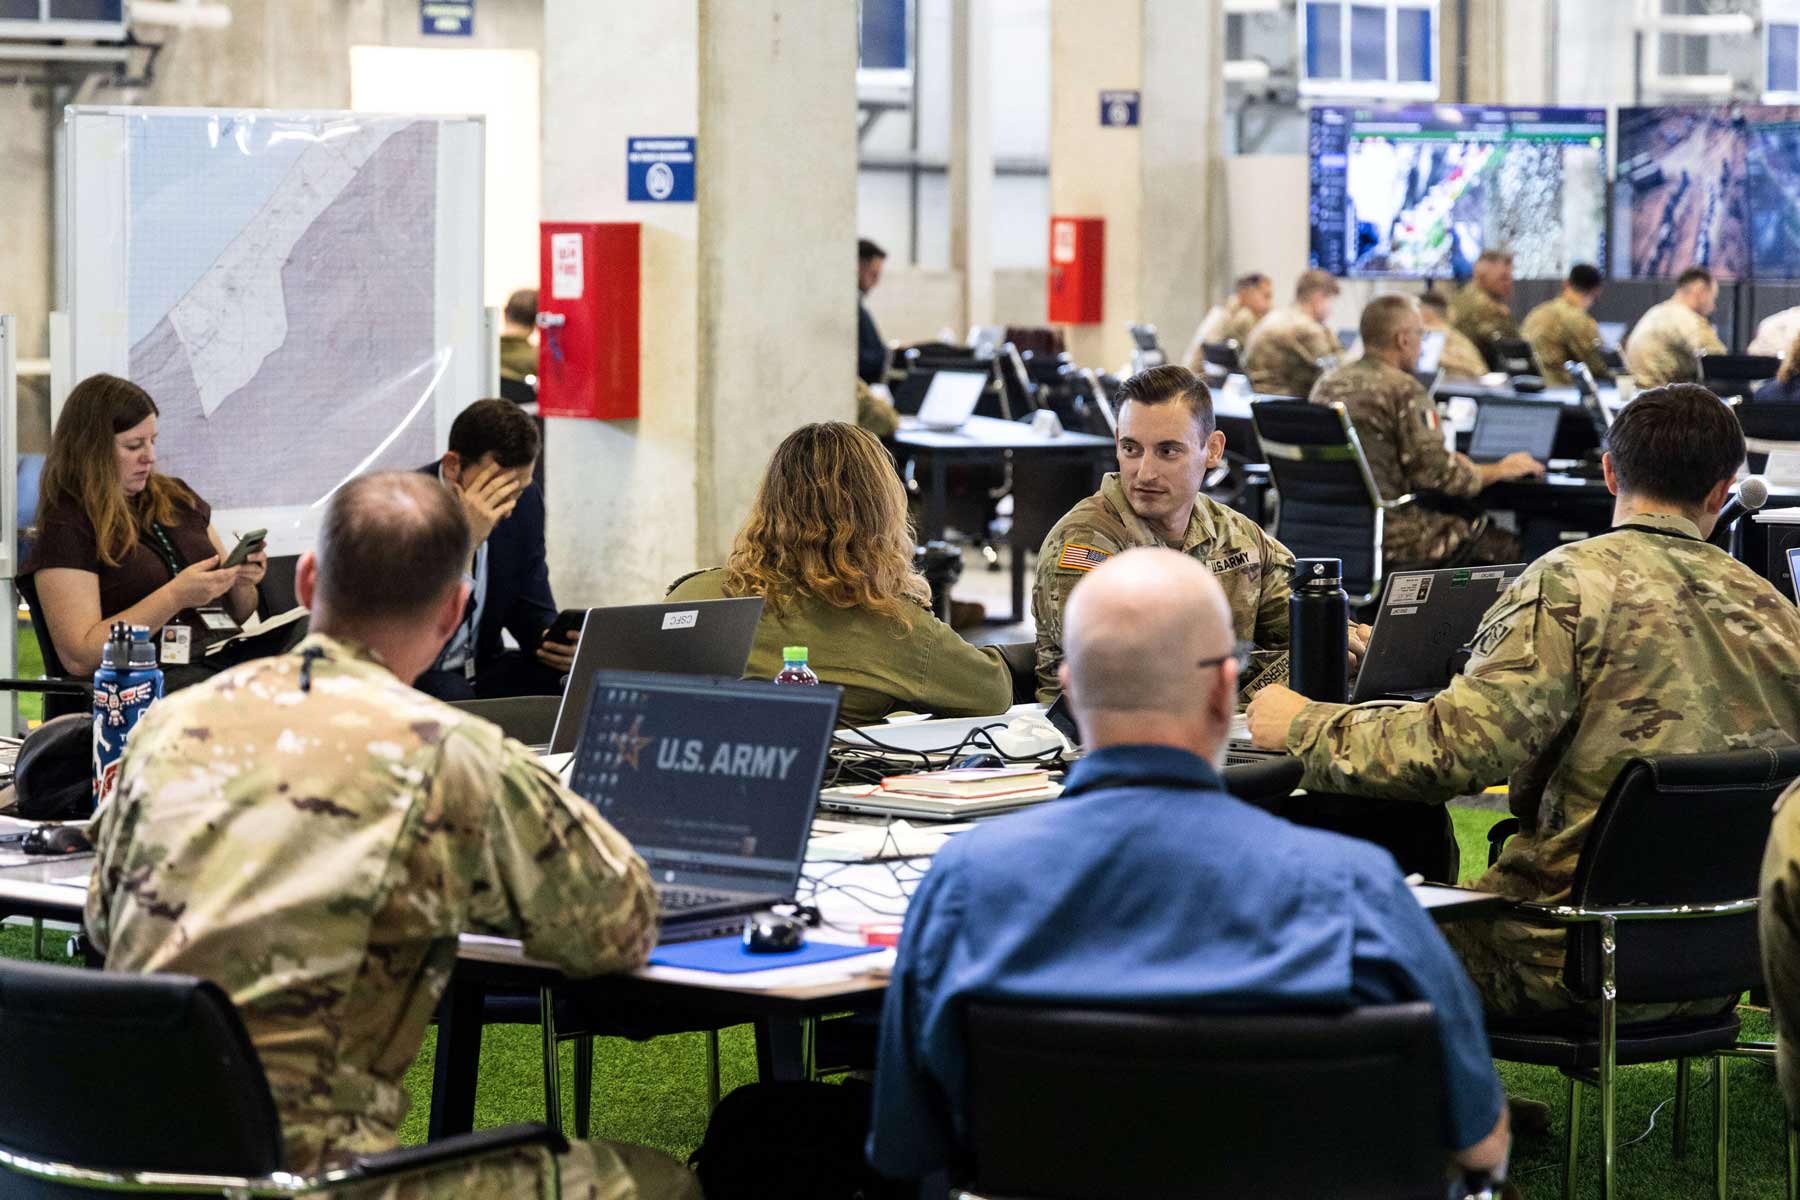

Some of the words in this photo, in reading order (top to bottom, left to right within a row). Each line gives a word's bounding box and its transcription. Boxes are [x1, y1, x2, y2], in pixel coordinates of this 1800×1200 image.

[1223, 551, 1250, 571] ARMY
[656, 737, 706, 773] U.S.
[709, 741, 800, 780] ARMY
